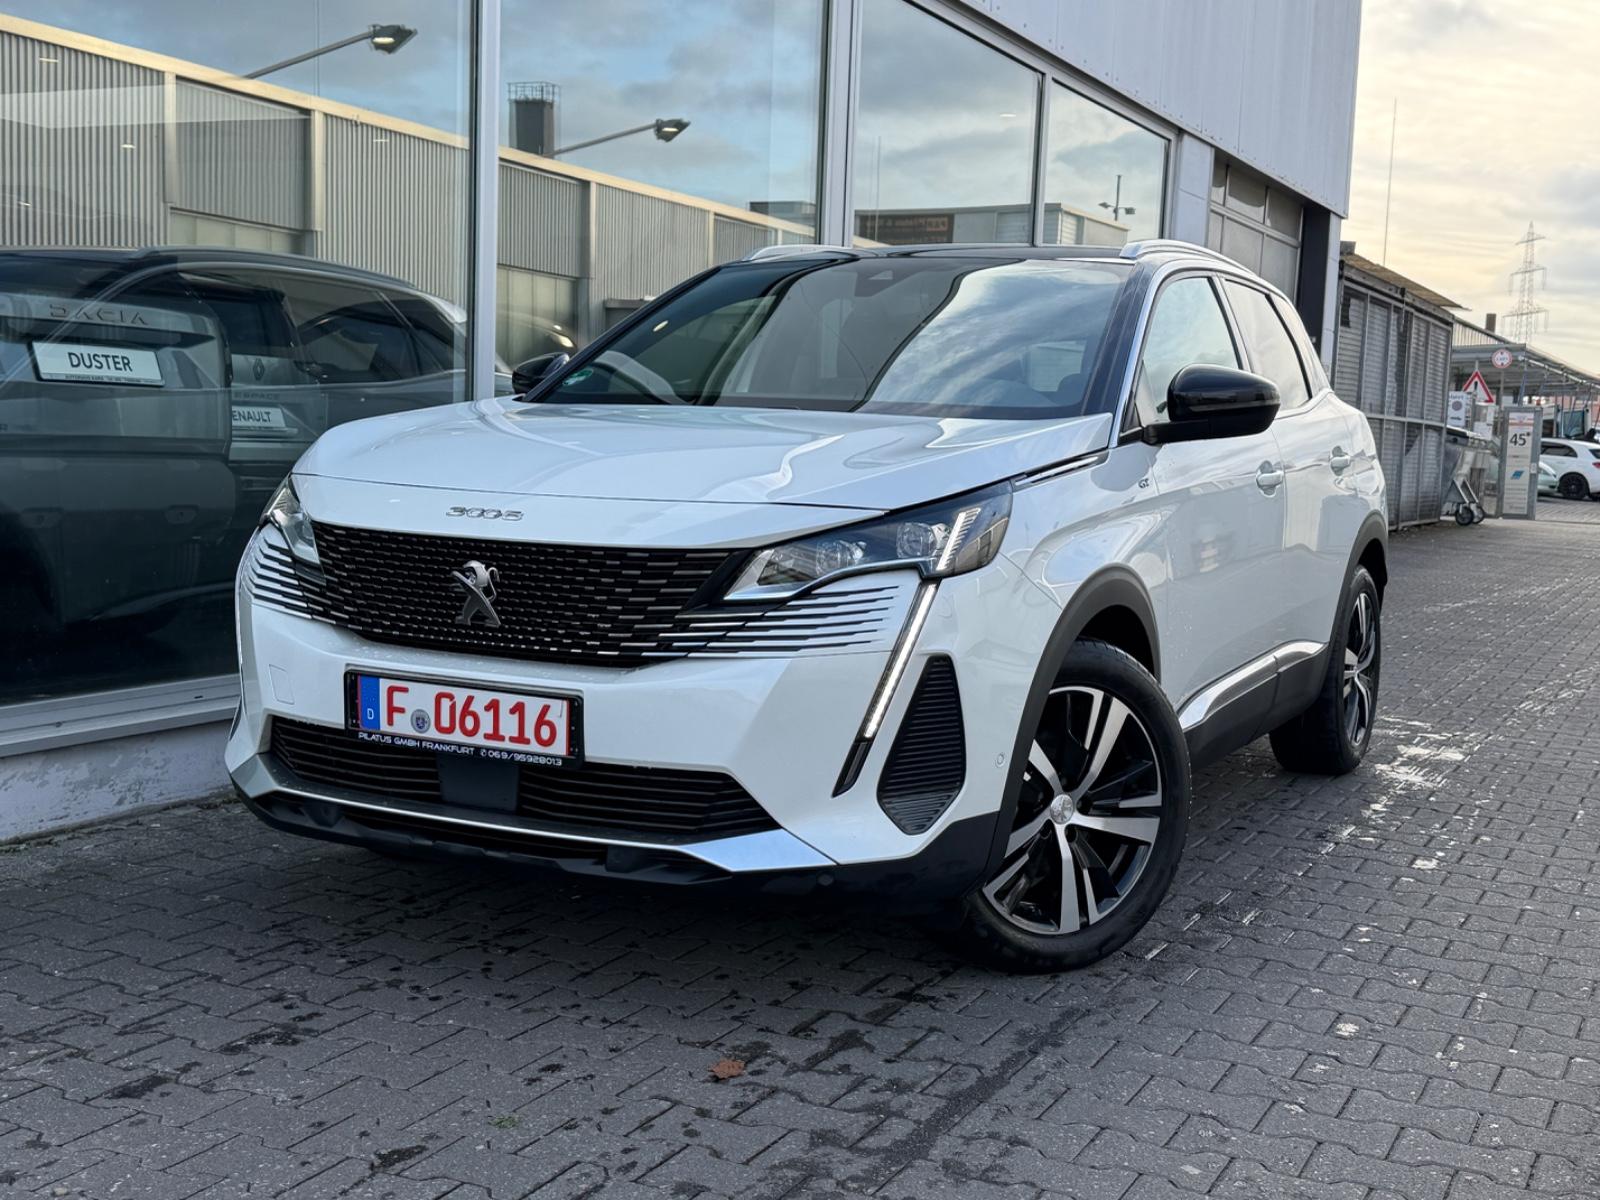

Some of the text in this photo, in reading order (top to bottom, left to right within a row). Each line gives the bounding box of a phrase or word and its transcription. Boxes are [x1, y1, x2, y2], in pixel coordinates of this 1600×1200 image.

[50, 303, 149, 326] DACIA
[68, 351, 133, 373] DUSTER
[232, 410, 272, 423] ENAULT
[366, 708, 375, 720] D
[386, 685, 557, 748] F 06116
[358, 731, 392, 744] PILATUS
[393, 736, 420, 748] GMBH
[421, 740, 475, 756] FRANKFURT
